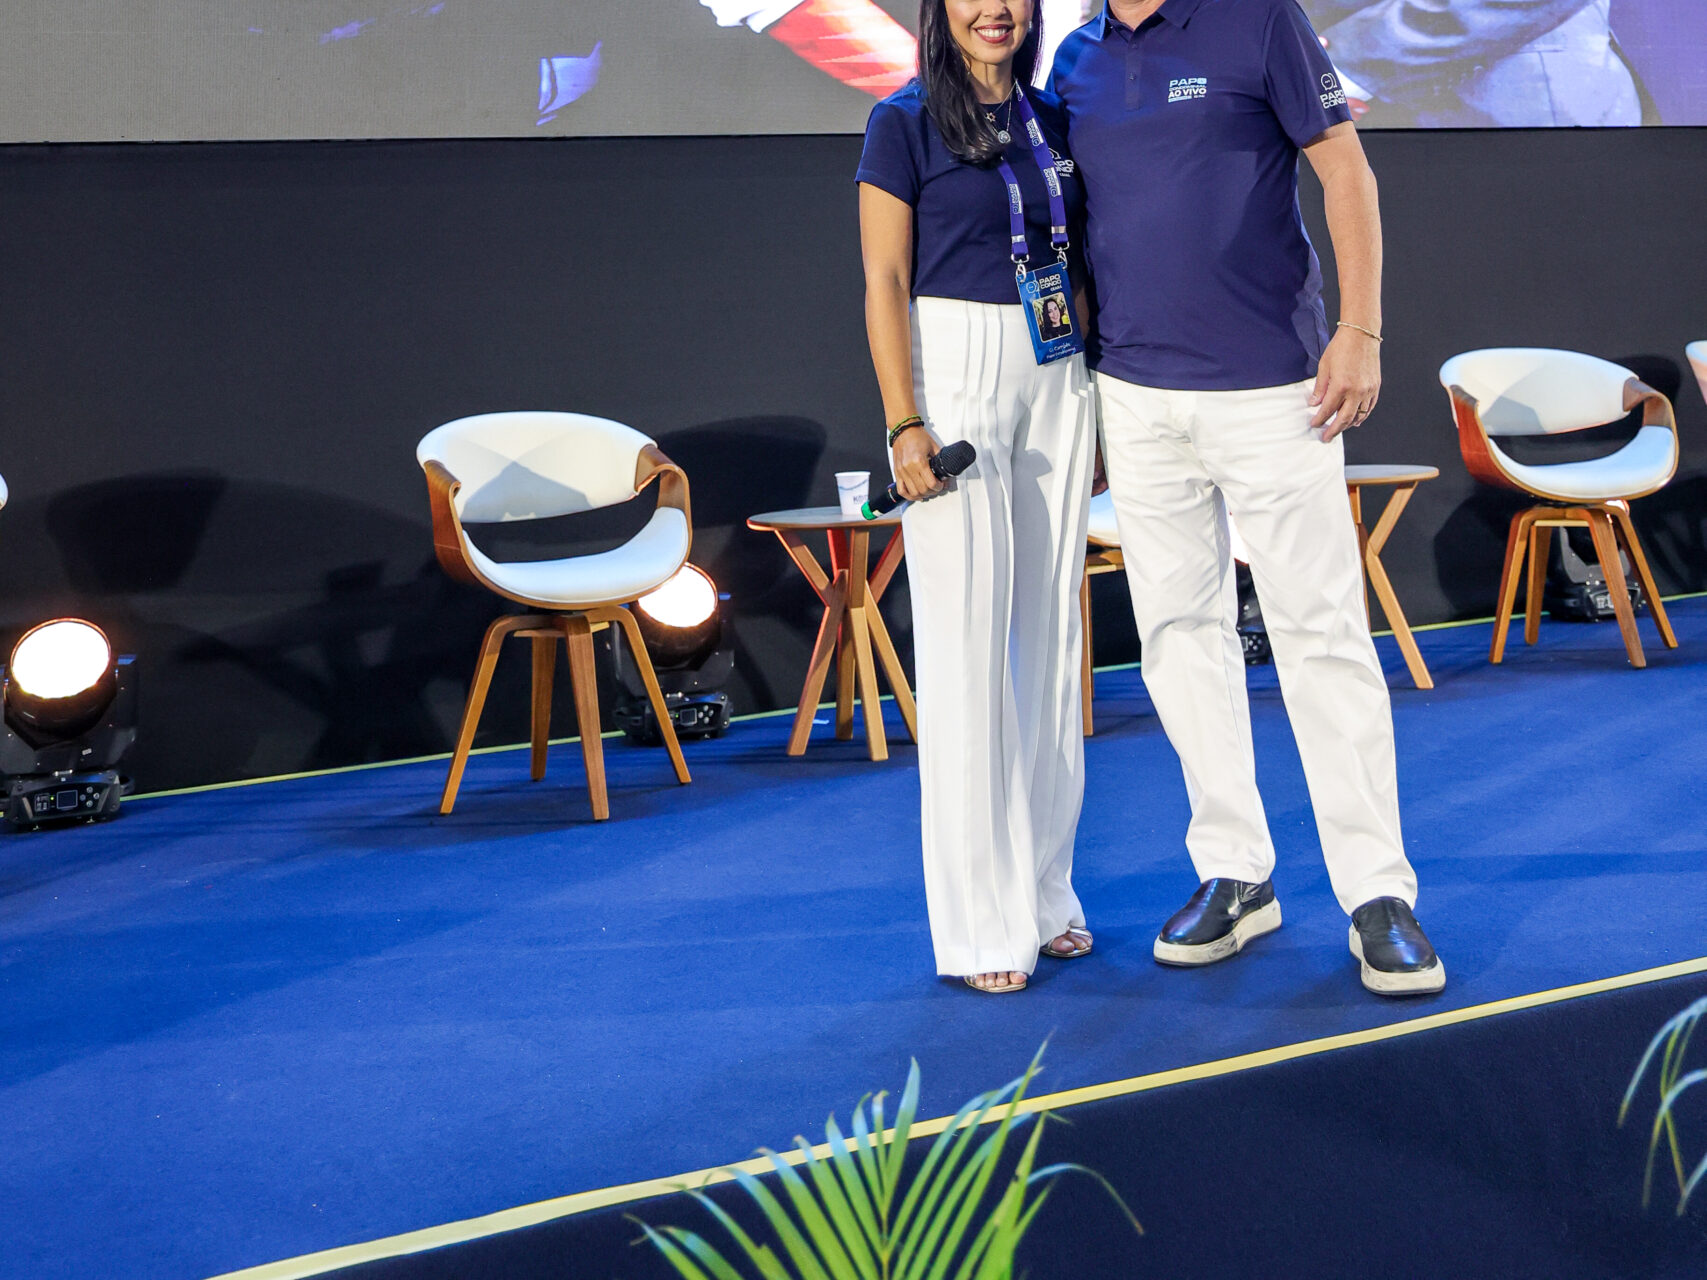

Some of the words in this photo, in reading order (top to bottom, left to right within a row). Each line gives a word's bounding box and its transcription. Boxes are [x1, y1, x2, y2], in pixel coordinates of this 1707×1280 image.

[1168, 90, 1182, 99] AO
[1182, 87, 1207, 96] VIVO
[1039, 274, 1061, 284] PAPO
